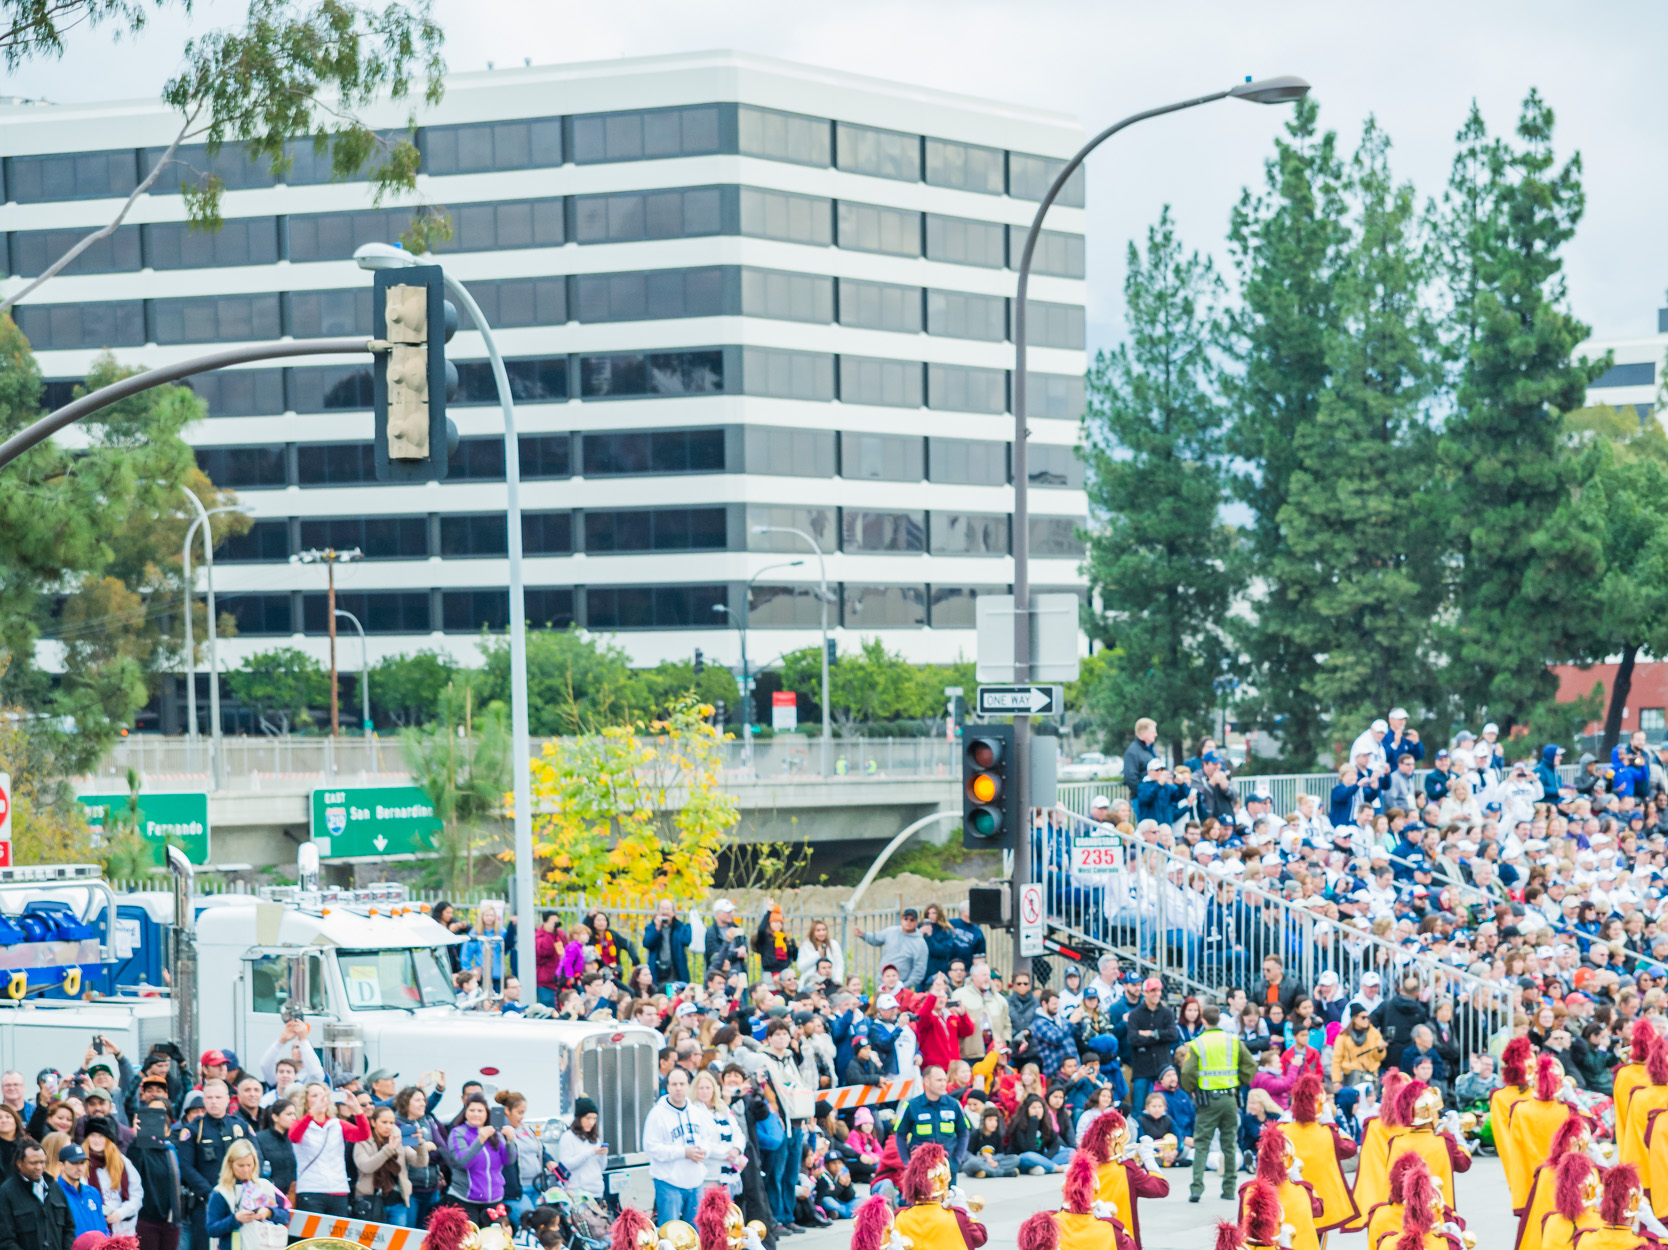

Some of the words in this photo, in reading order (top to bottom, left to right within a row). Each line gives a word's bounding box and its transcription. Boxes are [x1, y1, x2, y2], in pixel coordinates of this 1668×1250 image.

[987, 695, 1007, 706] ONE
[1011, 695, 1031, 705] WAY
[324, 791, 346, 804] EAST
[350, 806, 370, 820] San
[146, 820, 204, 837] Fernando
[1082, 849, 1114, 865] 235
[358, 981, 375, 1002] D
[328, 1224, 343, 1236] CITY
[345, 1226, 353, 1238] OF
[355, 1230, 386, 1244] PASADENA
